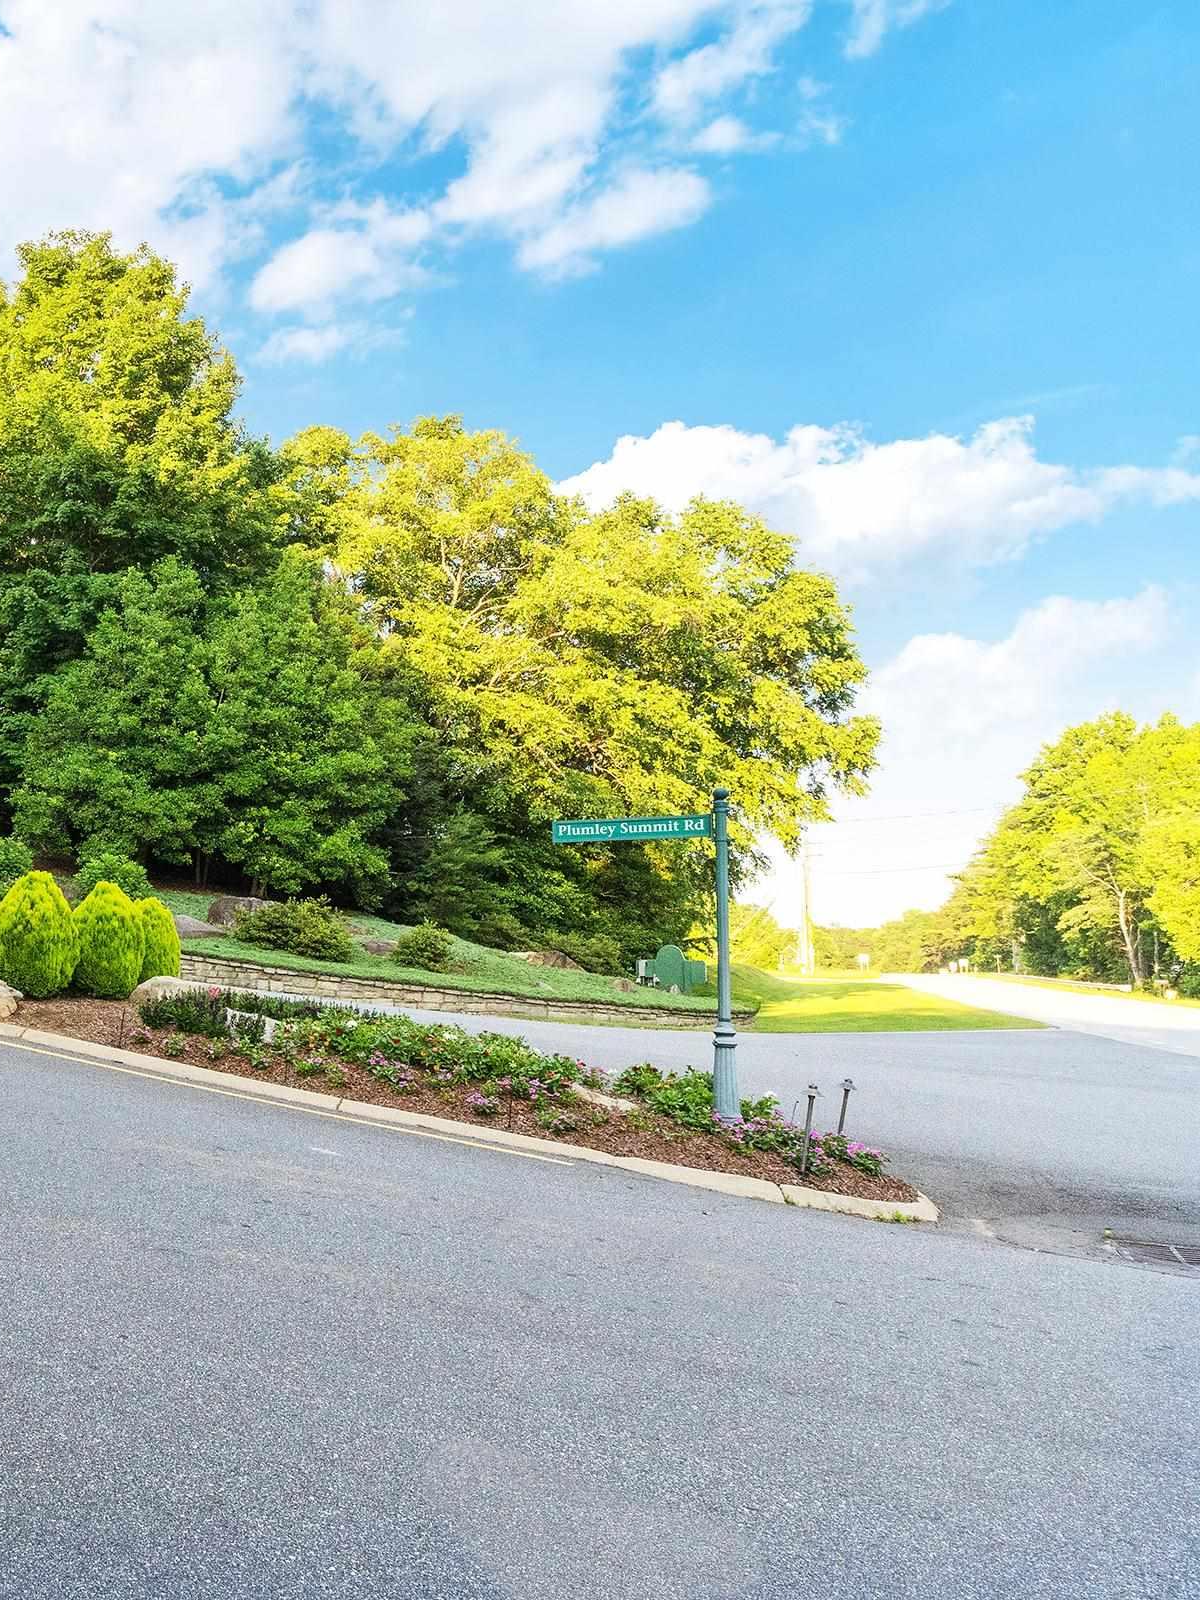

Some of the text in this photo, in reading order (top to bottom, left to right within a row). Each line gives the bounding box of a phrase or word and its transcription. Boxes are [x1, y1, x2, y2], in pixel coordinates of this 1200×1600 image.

[558, 818, 705, 837] Plumley Summit Rd
